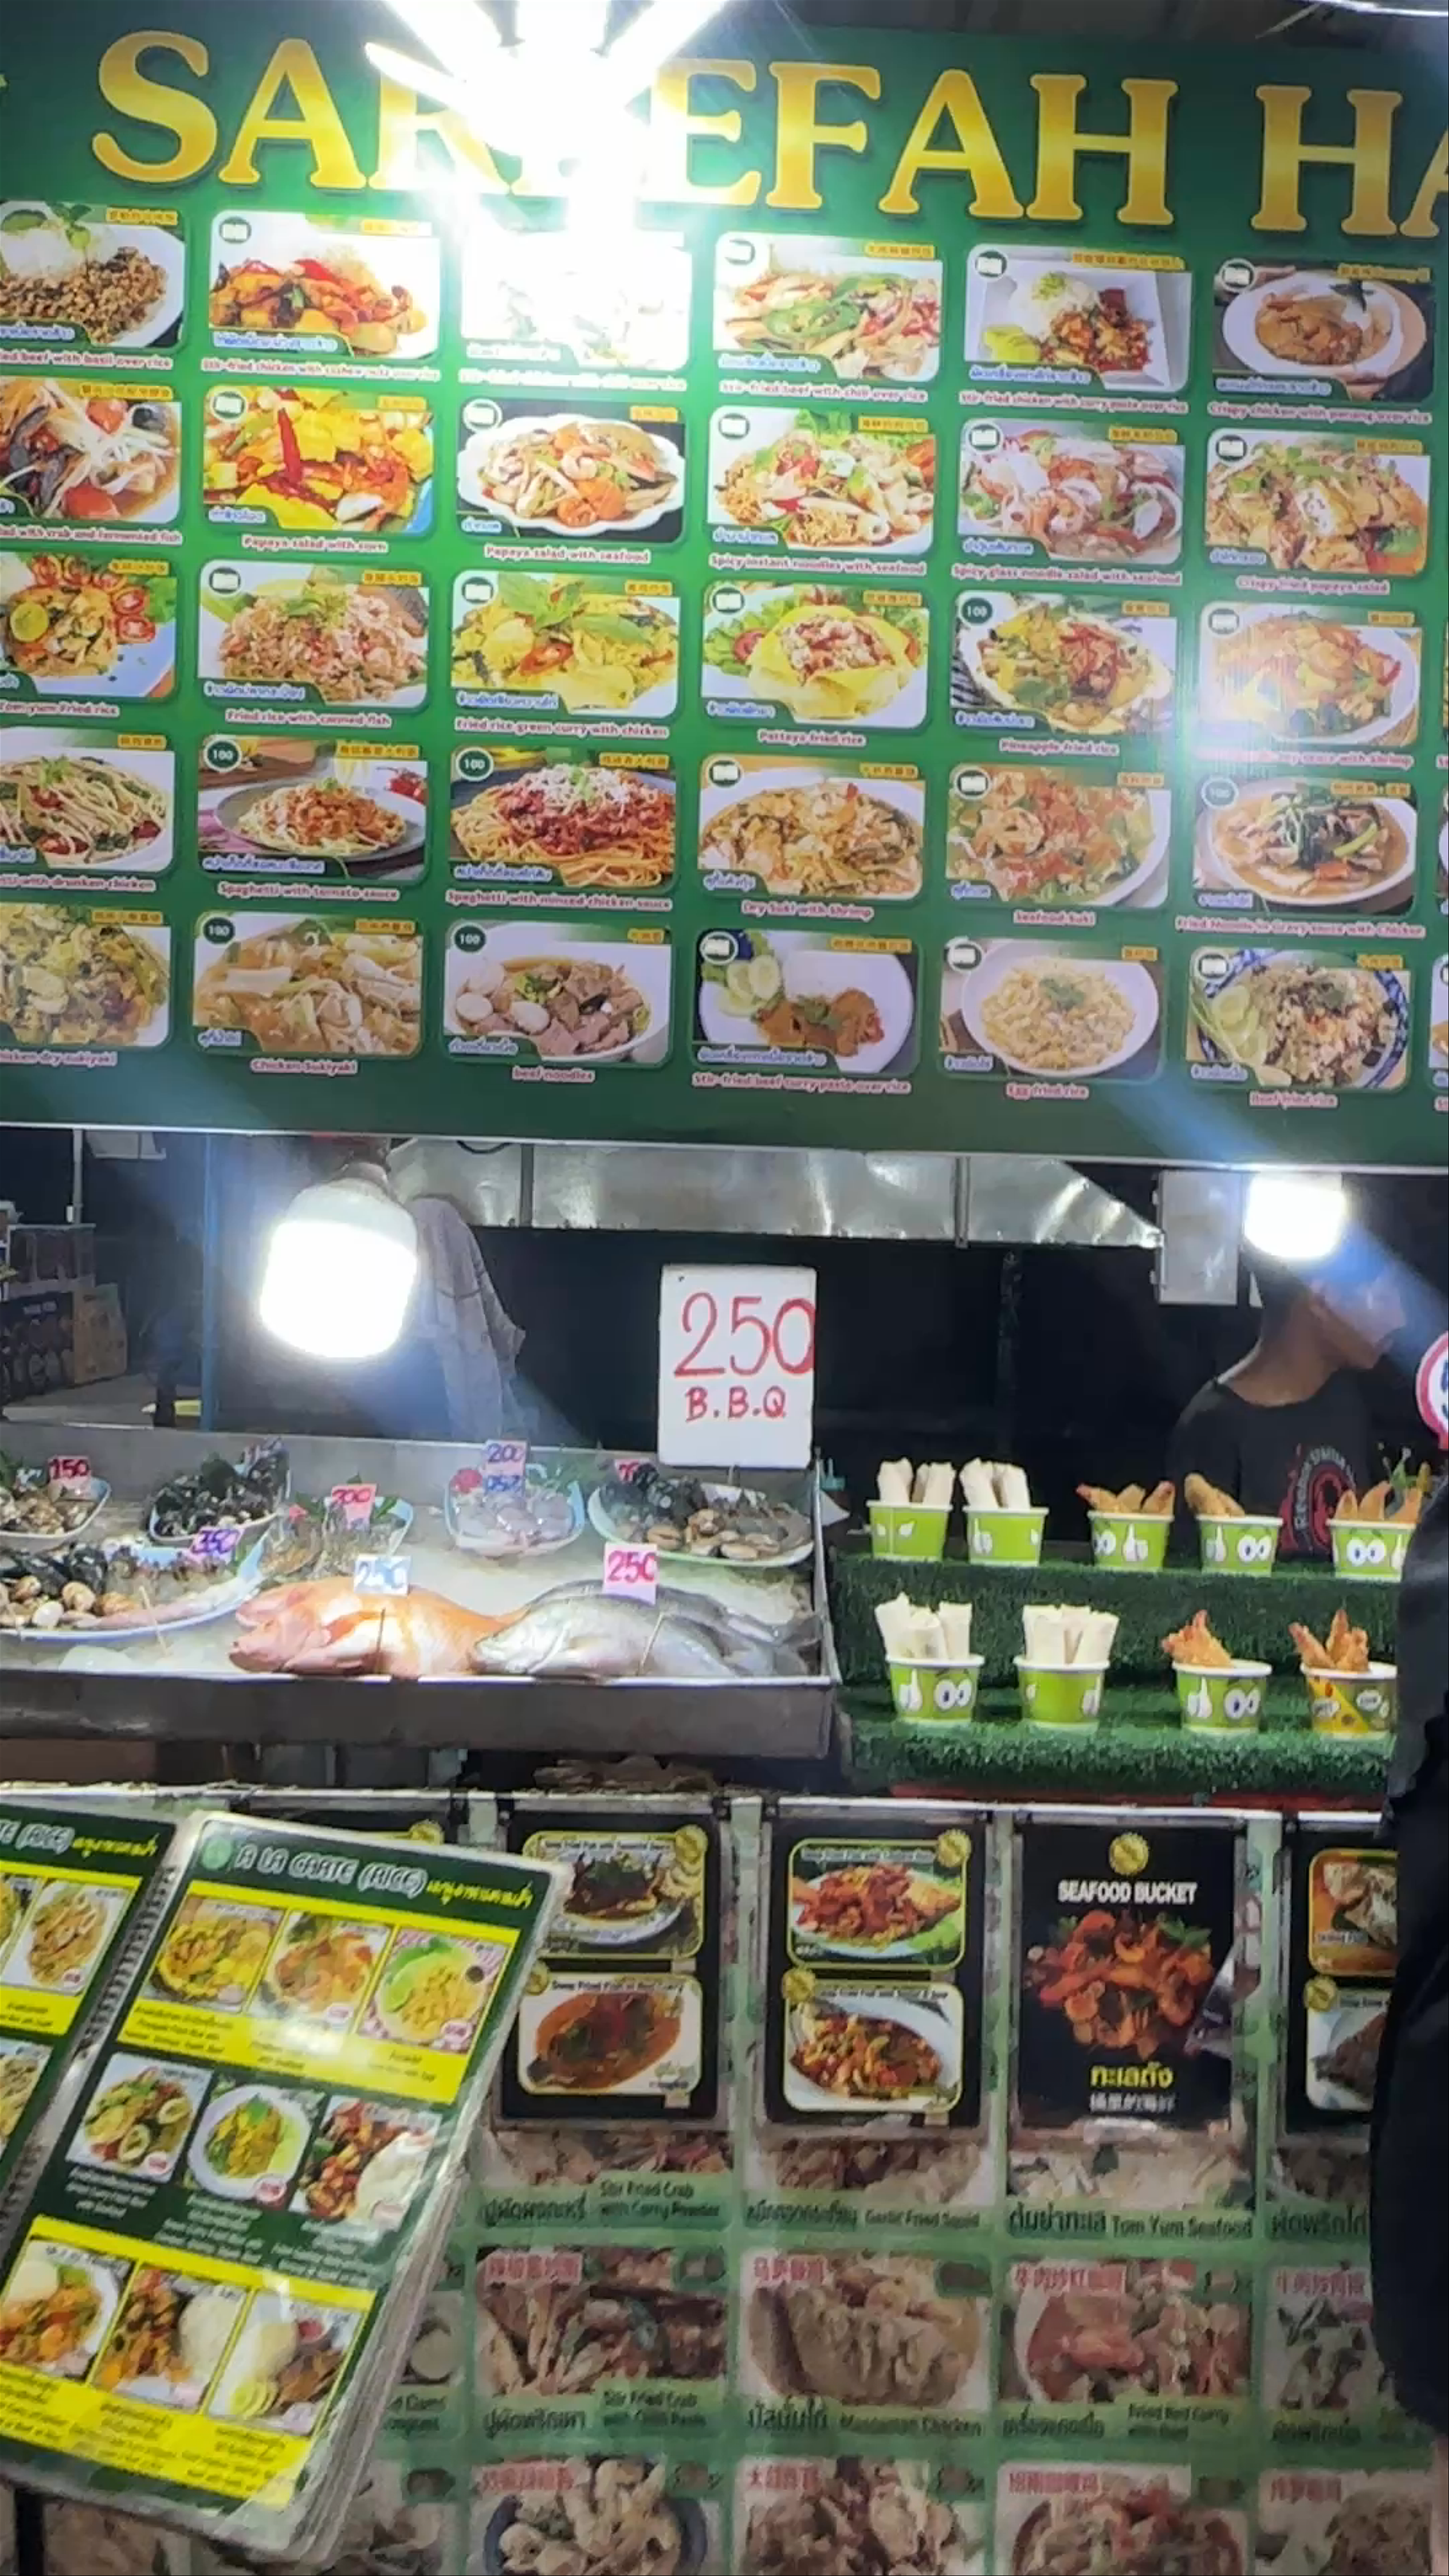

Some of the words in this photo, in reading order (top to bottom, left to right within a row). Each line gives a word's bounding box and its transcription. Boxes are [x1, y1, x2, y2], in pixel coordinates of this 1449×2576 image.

[93, 30, 1177, 228] SAREFAH
[968, 605, 988, 617] 100
[213, 750, 234, 760] 100
[465, 758, 486, 770] 100
[208, 925, 230, 937] 100
[460, 933, 481, 945] 100
[674, 1292, 817, 1377] 250
[685, 1386, 787, 1423] B.B.Q
[49, 1459, 90, 1479] 150
[1058, 1880, 1131, 1903] SEAFOOD
[1134, 1881, 1198, 1905] BUCKET
[1112, 2215, 1146, 2236] Tom
[1149, 2214, 1183, 2237] Yum
